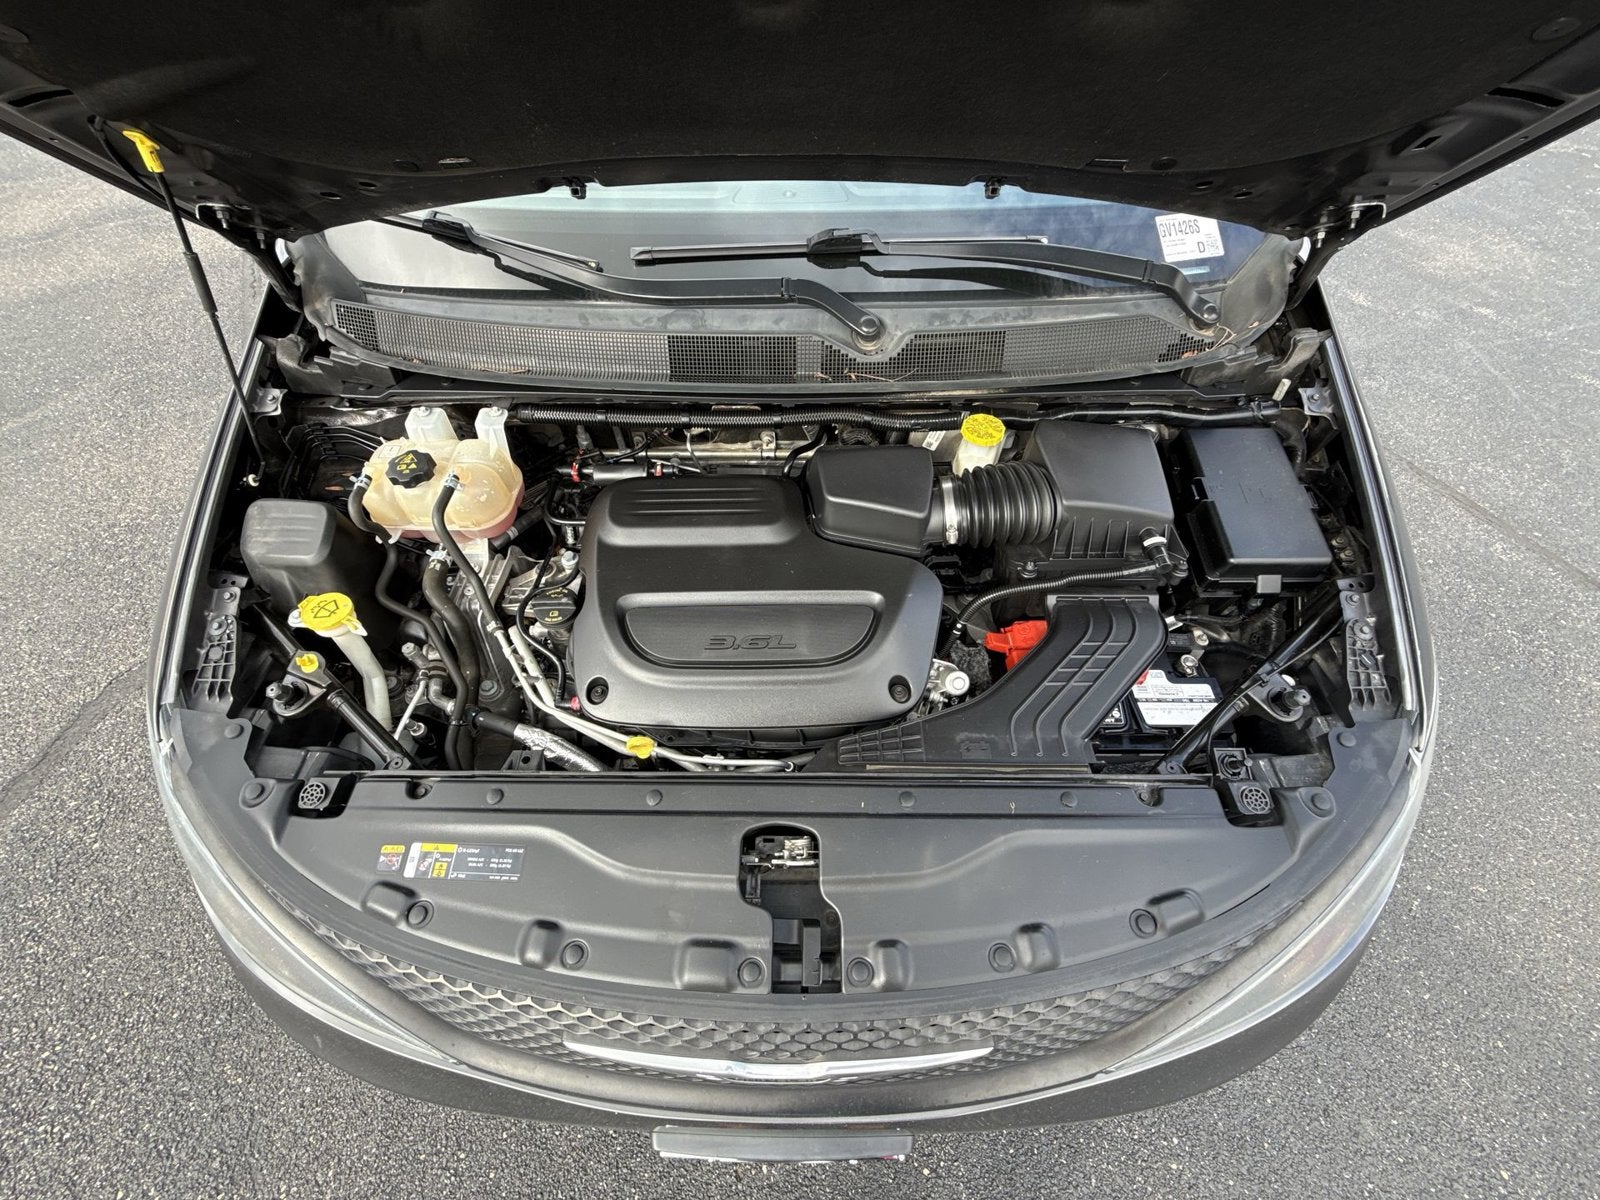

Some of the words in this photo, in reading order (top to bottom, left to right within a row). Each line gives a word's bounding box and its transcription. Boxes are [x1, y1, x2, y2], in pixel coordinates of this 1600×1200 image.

[1158, 219, 1201, 238] GV1426S
[1197, 241, 1206, 253] D
[703, 634, 797, 650] 3.6L
